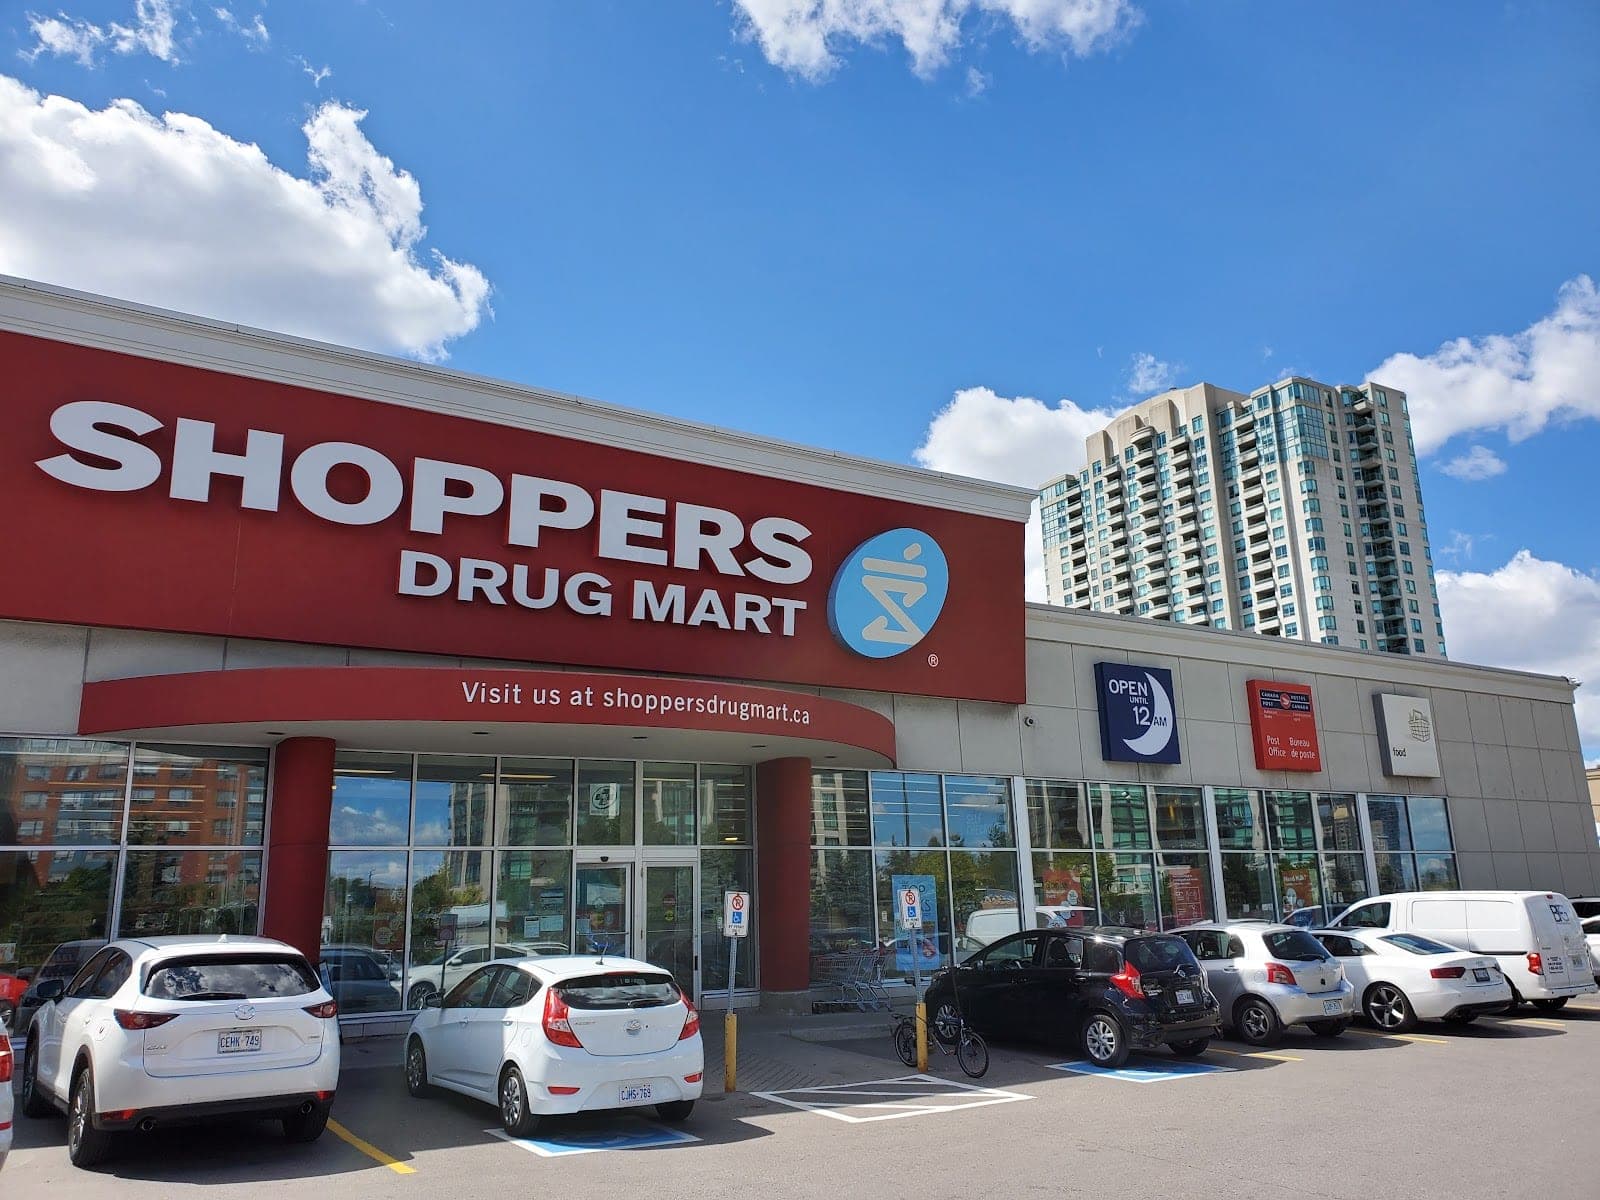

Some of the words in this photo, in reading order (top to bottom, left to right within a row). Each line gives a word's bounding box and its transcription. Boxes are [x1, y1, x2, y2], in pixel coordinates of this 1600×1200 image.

[34, 401, 813, 585] SHOPPERS
[398, 549, 613, 617] DRUG
[631, 579, 808, 637] MART
[1108, 678, 1148, 697] OPEN
[1129, 695, 1149, 705] UNTIL
[1261, 691, 1280, 699] CANADA
[461, 681, 522, 704] Visit
[533, 688, 561, 705] us
[569, 687, 594, 707] at
[602, 688, 811, 726] shoppersdrugmart.ca
[1132, 705, 1151, 726] 12
[1153, 716, 1168, 727] AM
[1266, 735, 1280, 745] Post
[1289, 736, 1310, 748] Bureau
[1268, 746, 1287, 758] Office
[1291, 748, 1299, 758] de
[1300, 751, 1316, 760] poste
[1392, 747, 1407, 757] food
